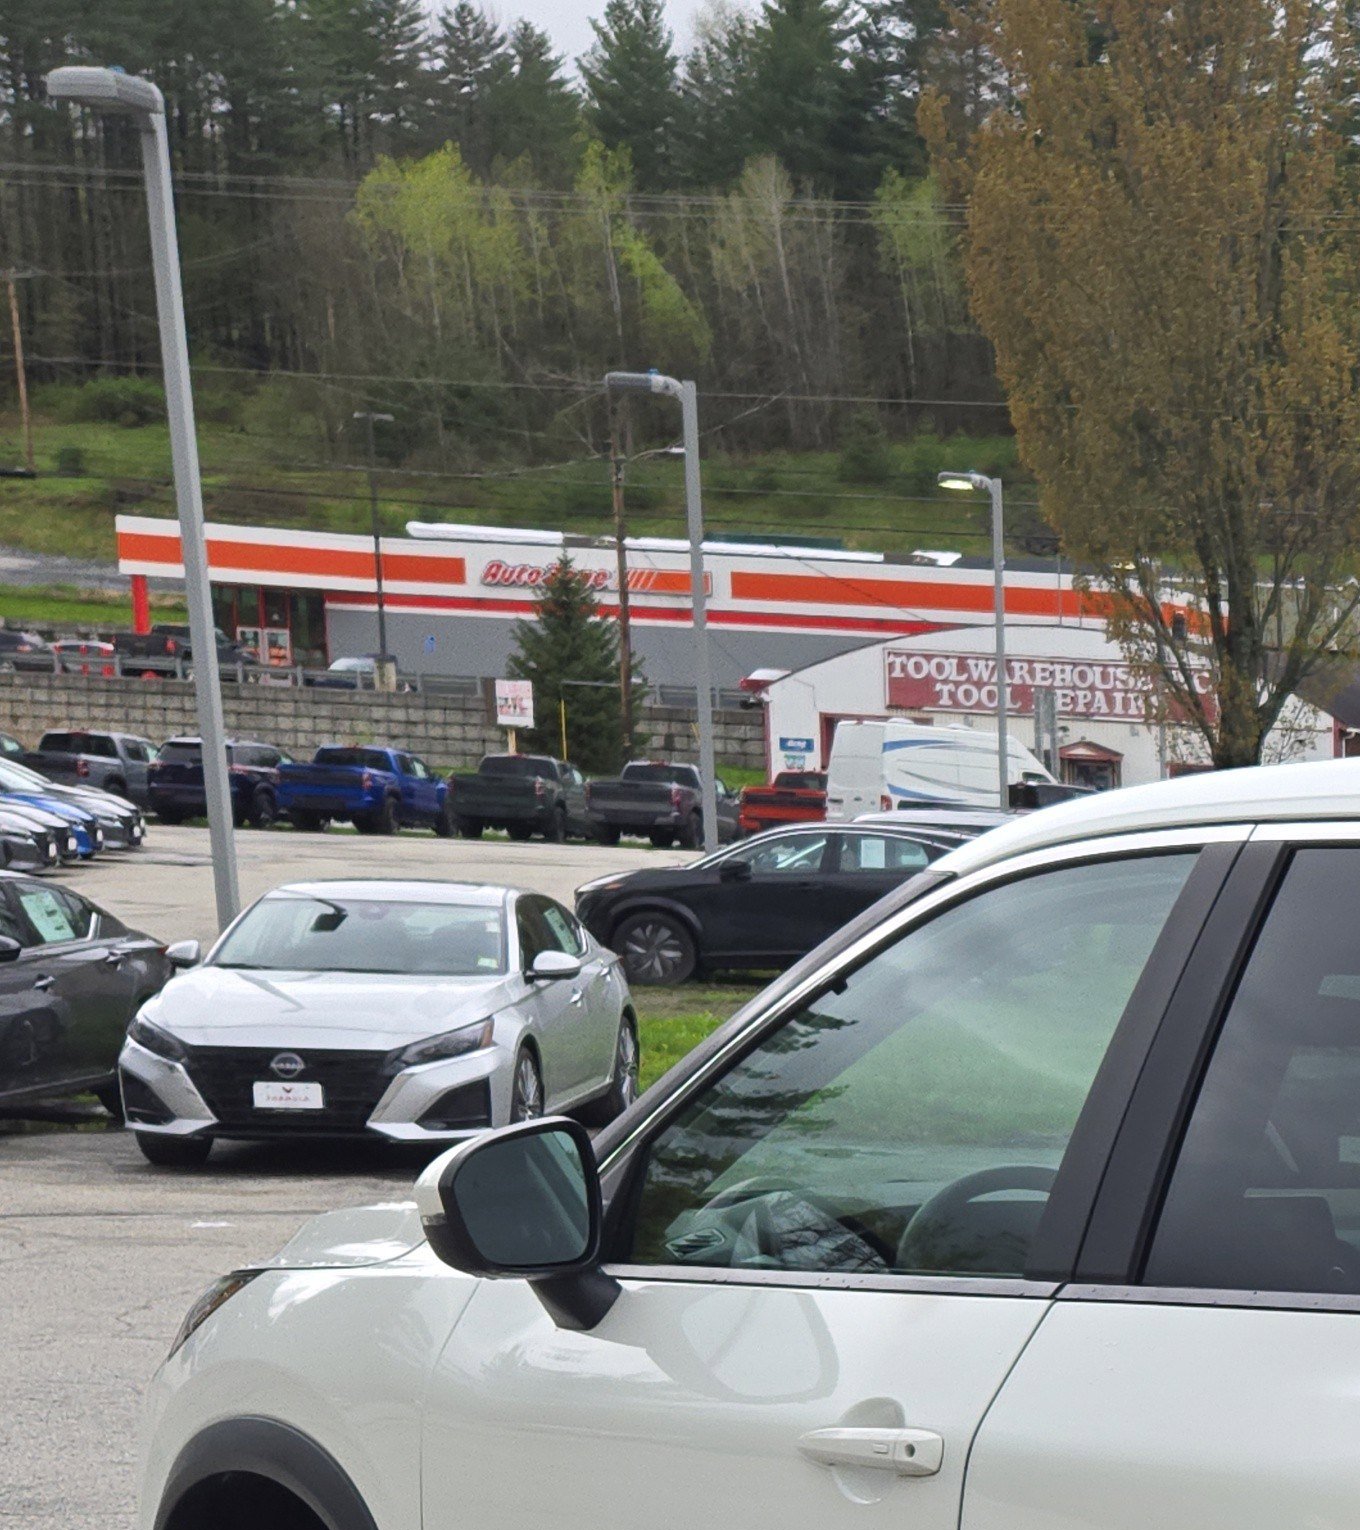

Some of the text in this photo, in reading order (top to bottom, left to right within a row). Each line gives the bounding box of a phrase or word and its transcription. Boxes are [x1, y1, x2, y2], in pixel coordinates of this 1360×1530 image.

[481, 560, 612, 590] Autone
[935, 683, 1159, 716] TOOL EPAIR
